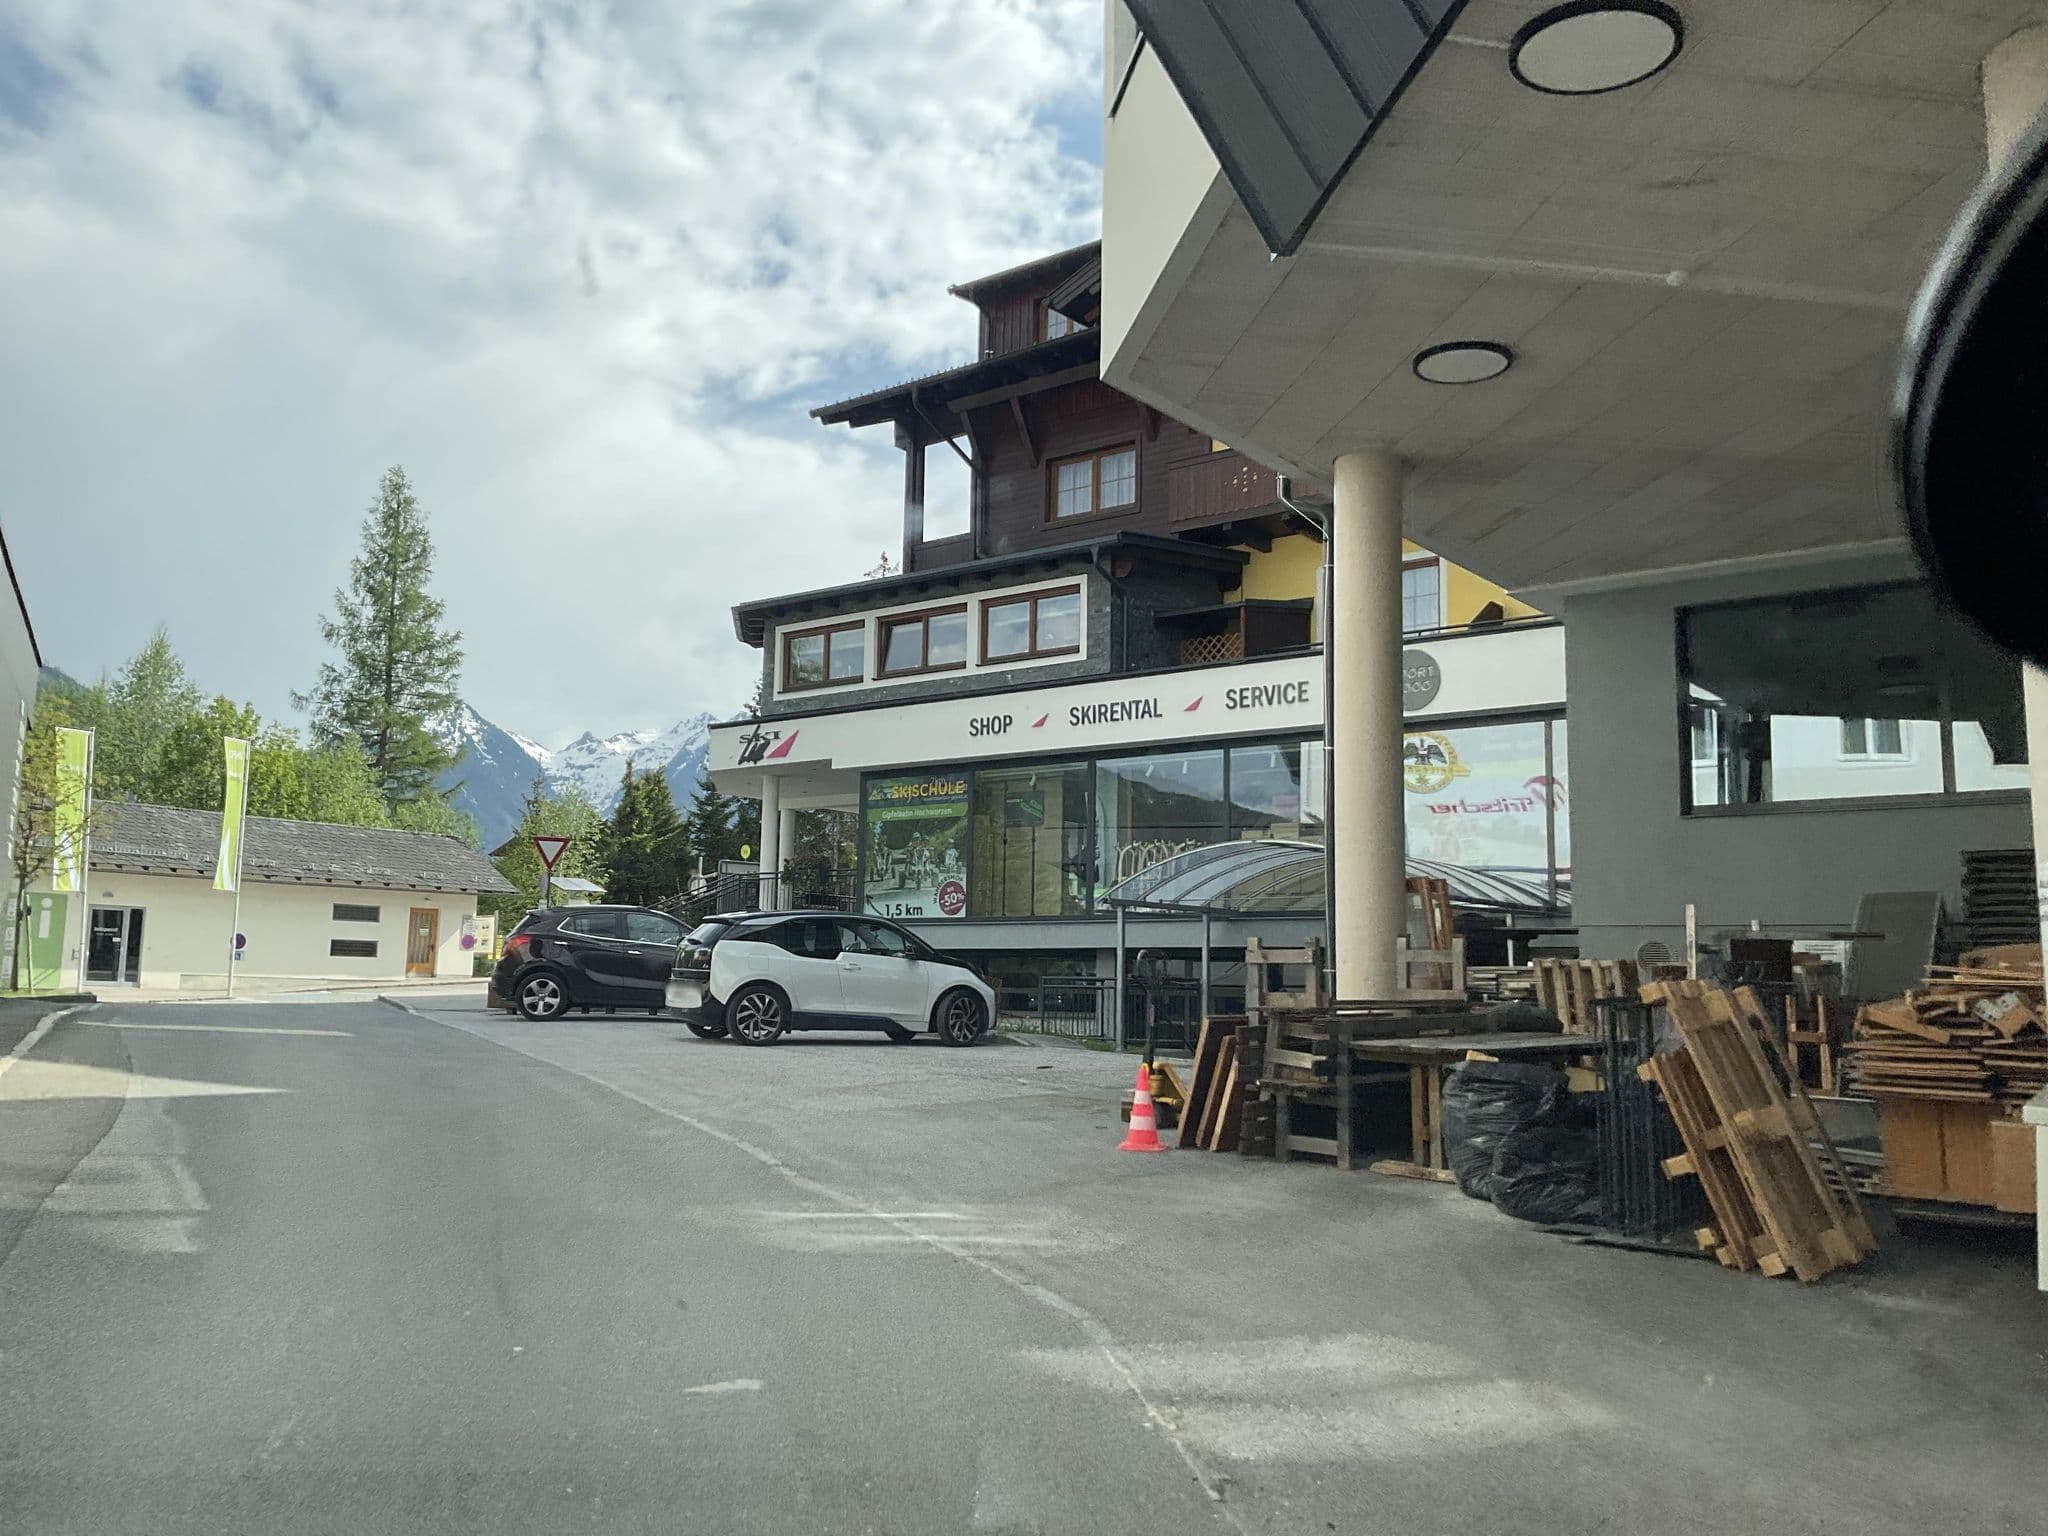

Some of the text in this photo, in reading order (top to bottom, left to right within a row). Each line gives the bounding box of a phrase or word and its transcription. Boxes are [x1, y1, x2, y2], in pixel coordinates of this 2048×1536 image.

[1403, 666, 1433, 679] ORT
[969, 681, 1310, 737] SHOP SKIRENTAL SERVICE
[885, 904, 923, 919] 1,5 km
